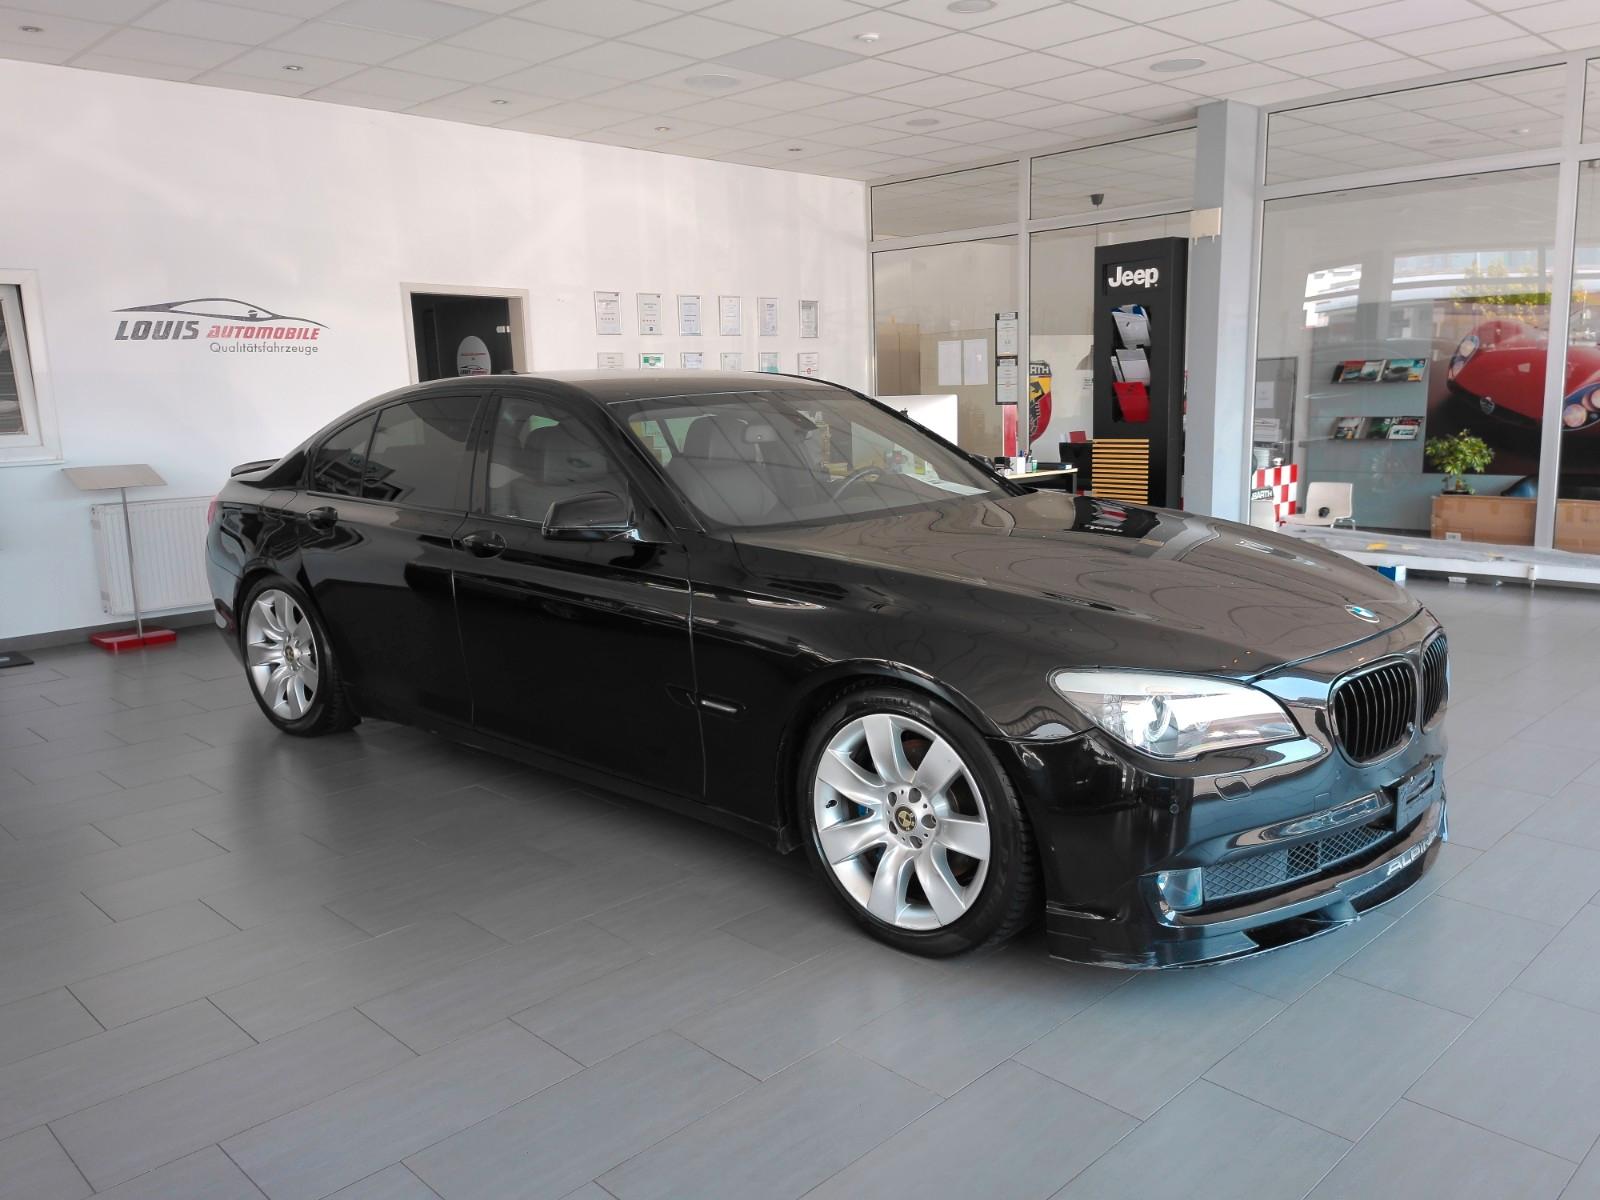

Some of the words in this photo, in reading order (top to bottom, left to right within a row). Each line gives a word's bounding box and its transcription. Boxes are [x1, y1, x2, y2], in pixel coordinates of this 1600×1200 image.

[1108, 265, 1159, 288] Jeep
[114, 320, 200, 341] LOUIS
[209, 341, 319, 356] Qualitätsfahrzeuge
[1251, 489, 1273, 501] BARTH
